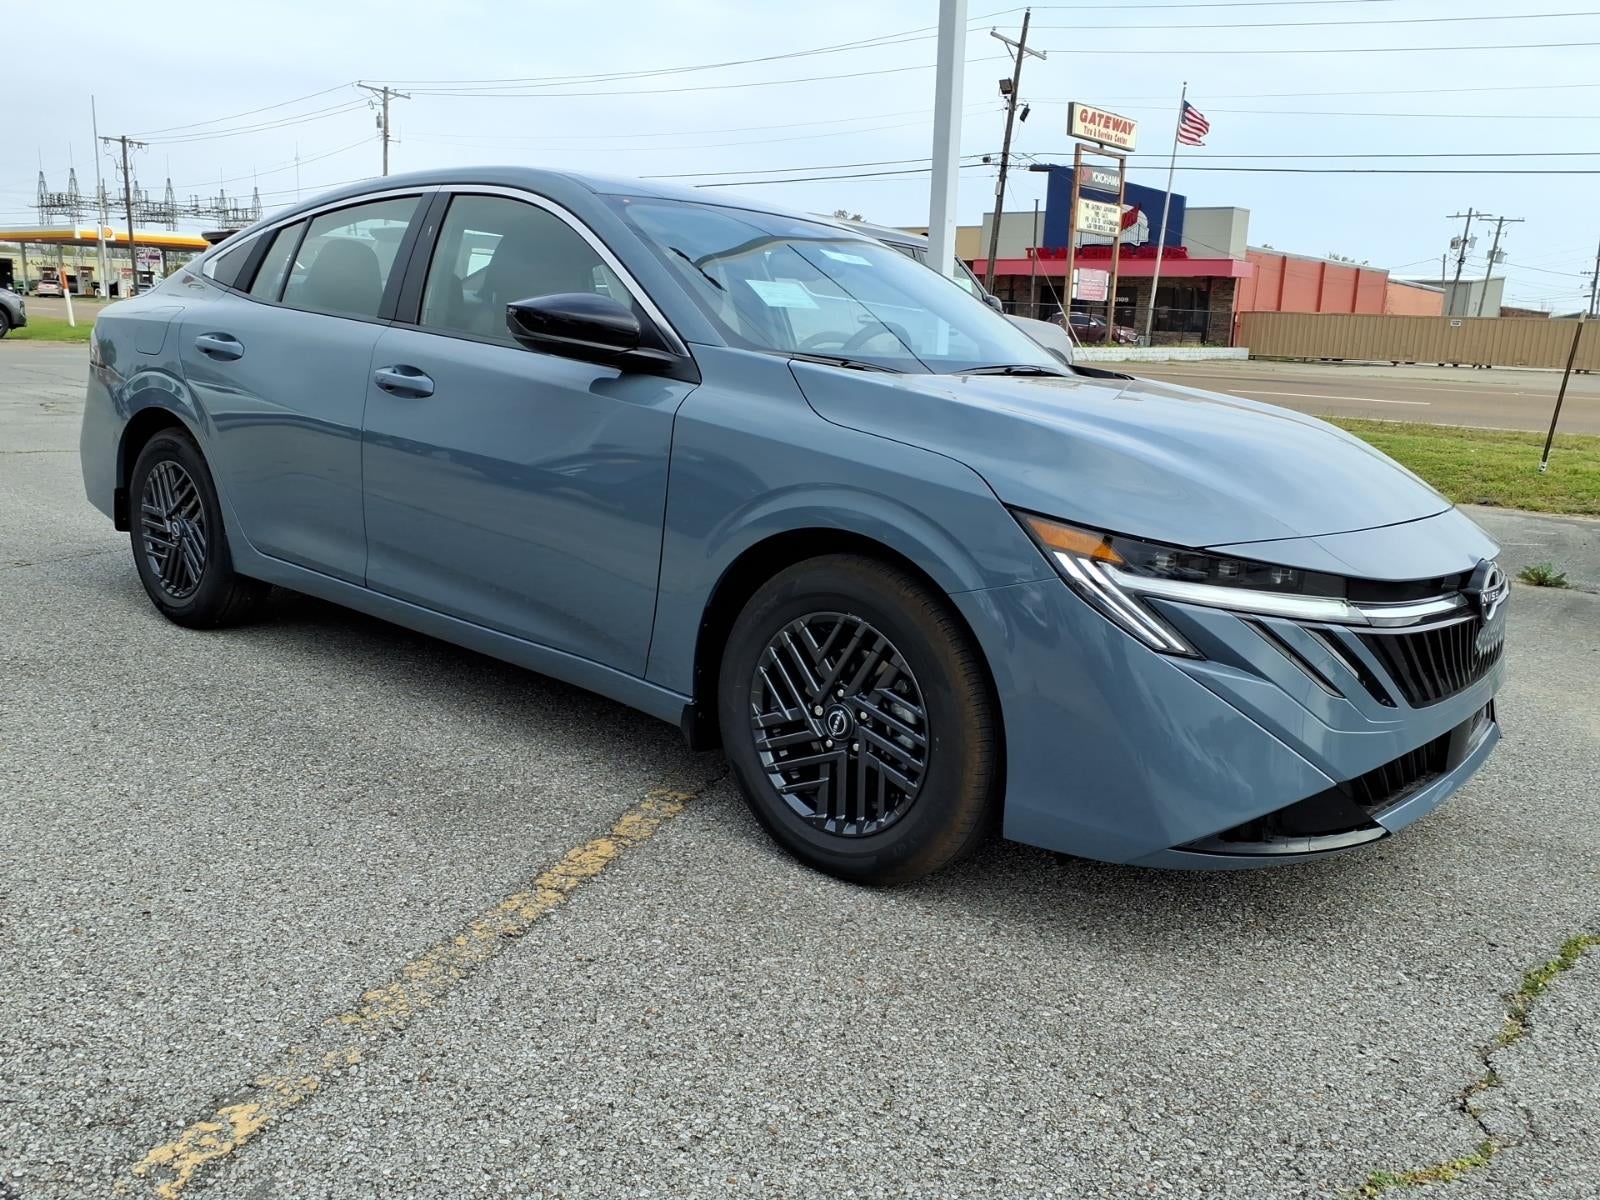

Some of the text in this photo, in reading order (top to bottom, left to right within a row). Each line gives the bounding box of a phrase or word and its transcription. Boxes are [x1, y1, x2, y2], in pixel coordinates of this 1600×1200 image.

[1080, 109, 1136, 136] GATEWAY
[1083, 125, 1092, 136] Tire
[1481, 590, 1499, 604] NISS
